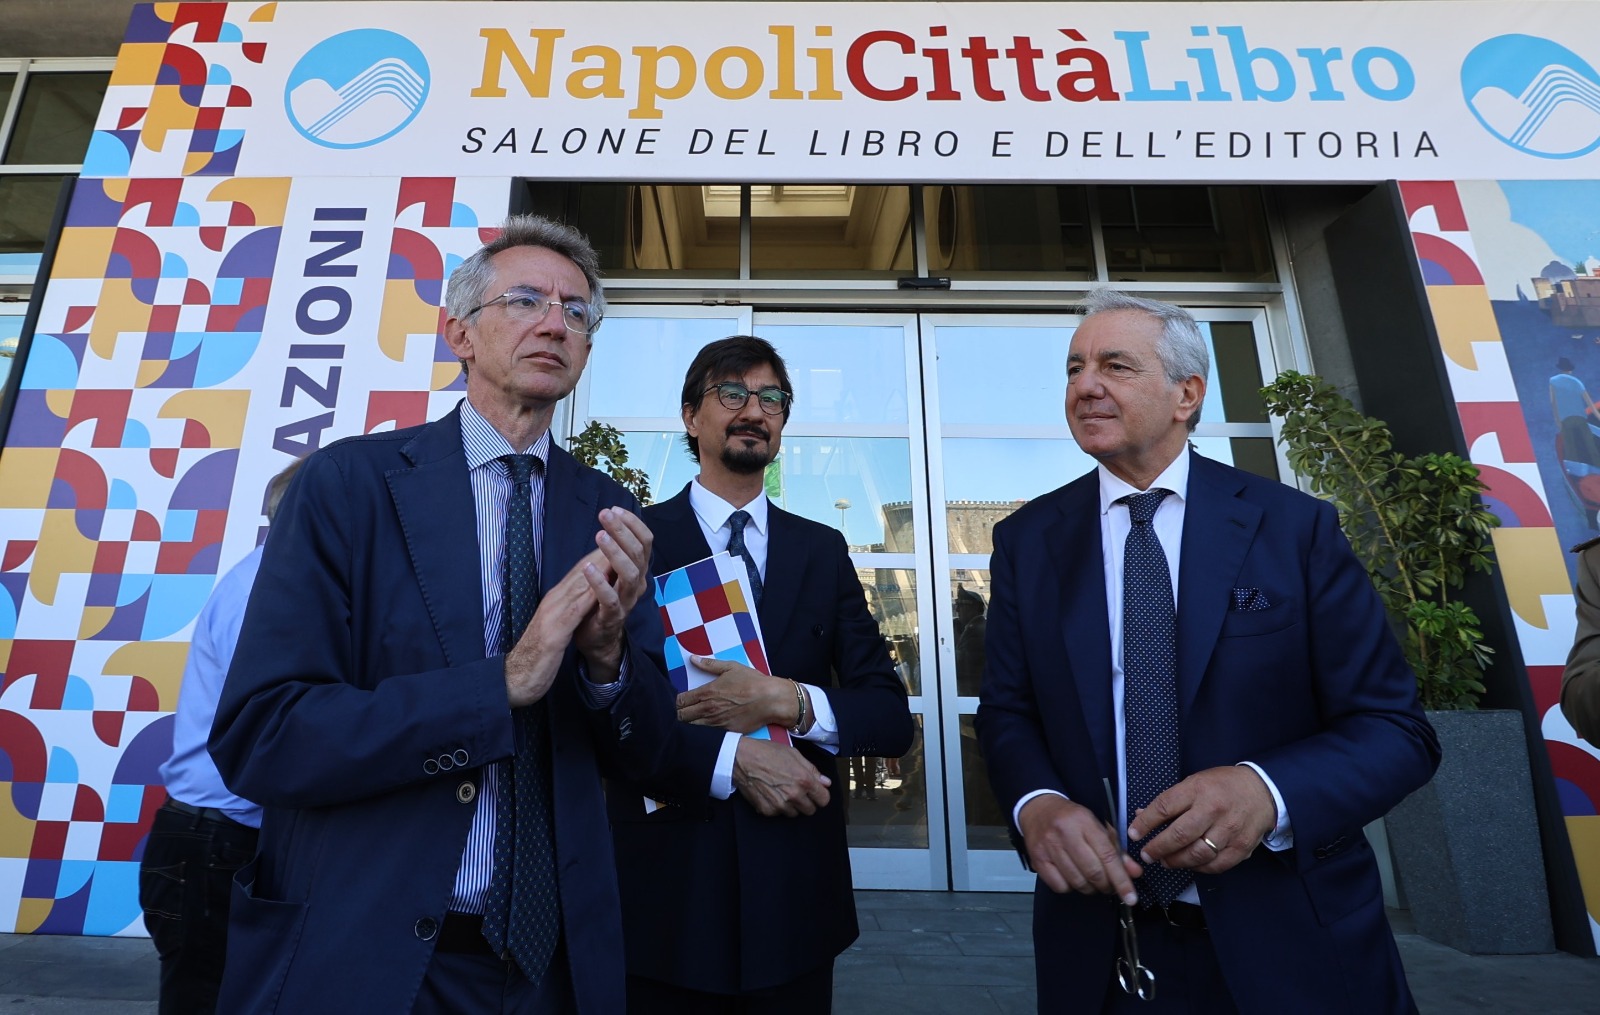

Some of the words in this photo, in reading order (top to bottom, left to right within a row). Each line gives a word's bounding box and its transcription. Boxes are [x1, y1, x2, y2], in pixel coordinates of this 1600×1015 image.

[471, 25, 1416, 119] NapoliCittàLibro
[461, 127, 661, 155] SALONE
[688, 128, 776, 156] DEL
[809, 129, 959, 157] LIBRO
[991, 130, 1014, 157] E
[1045, 130, 1438, 159] DELL'EDITORIA
[255, 207, 368, 549] AZIONI
